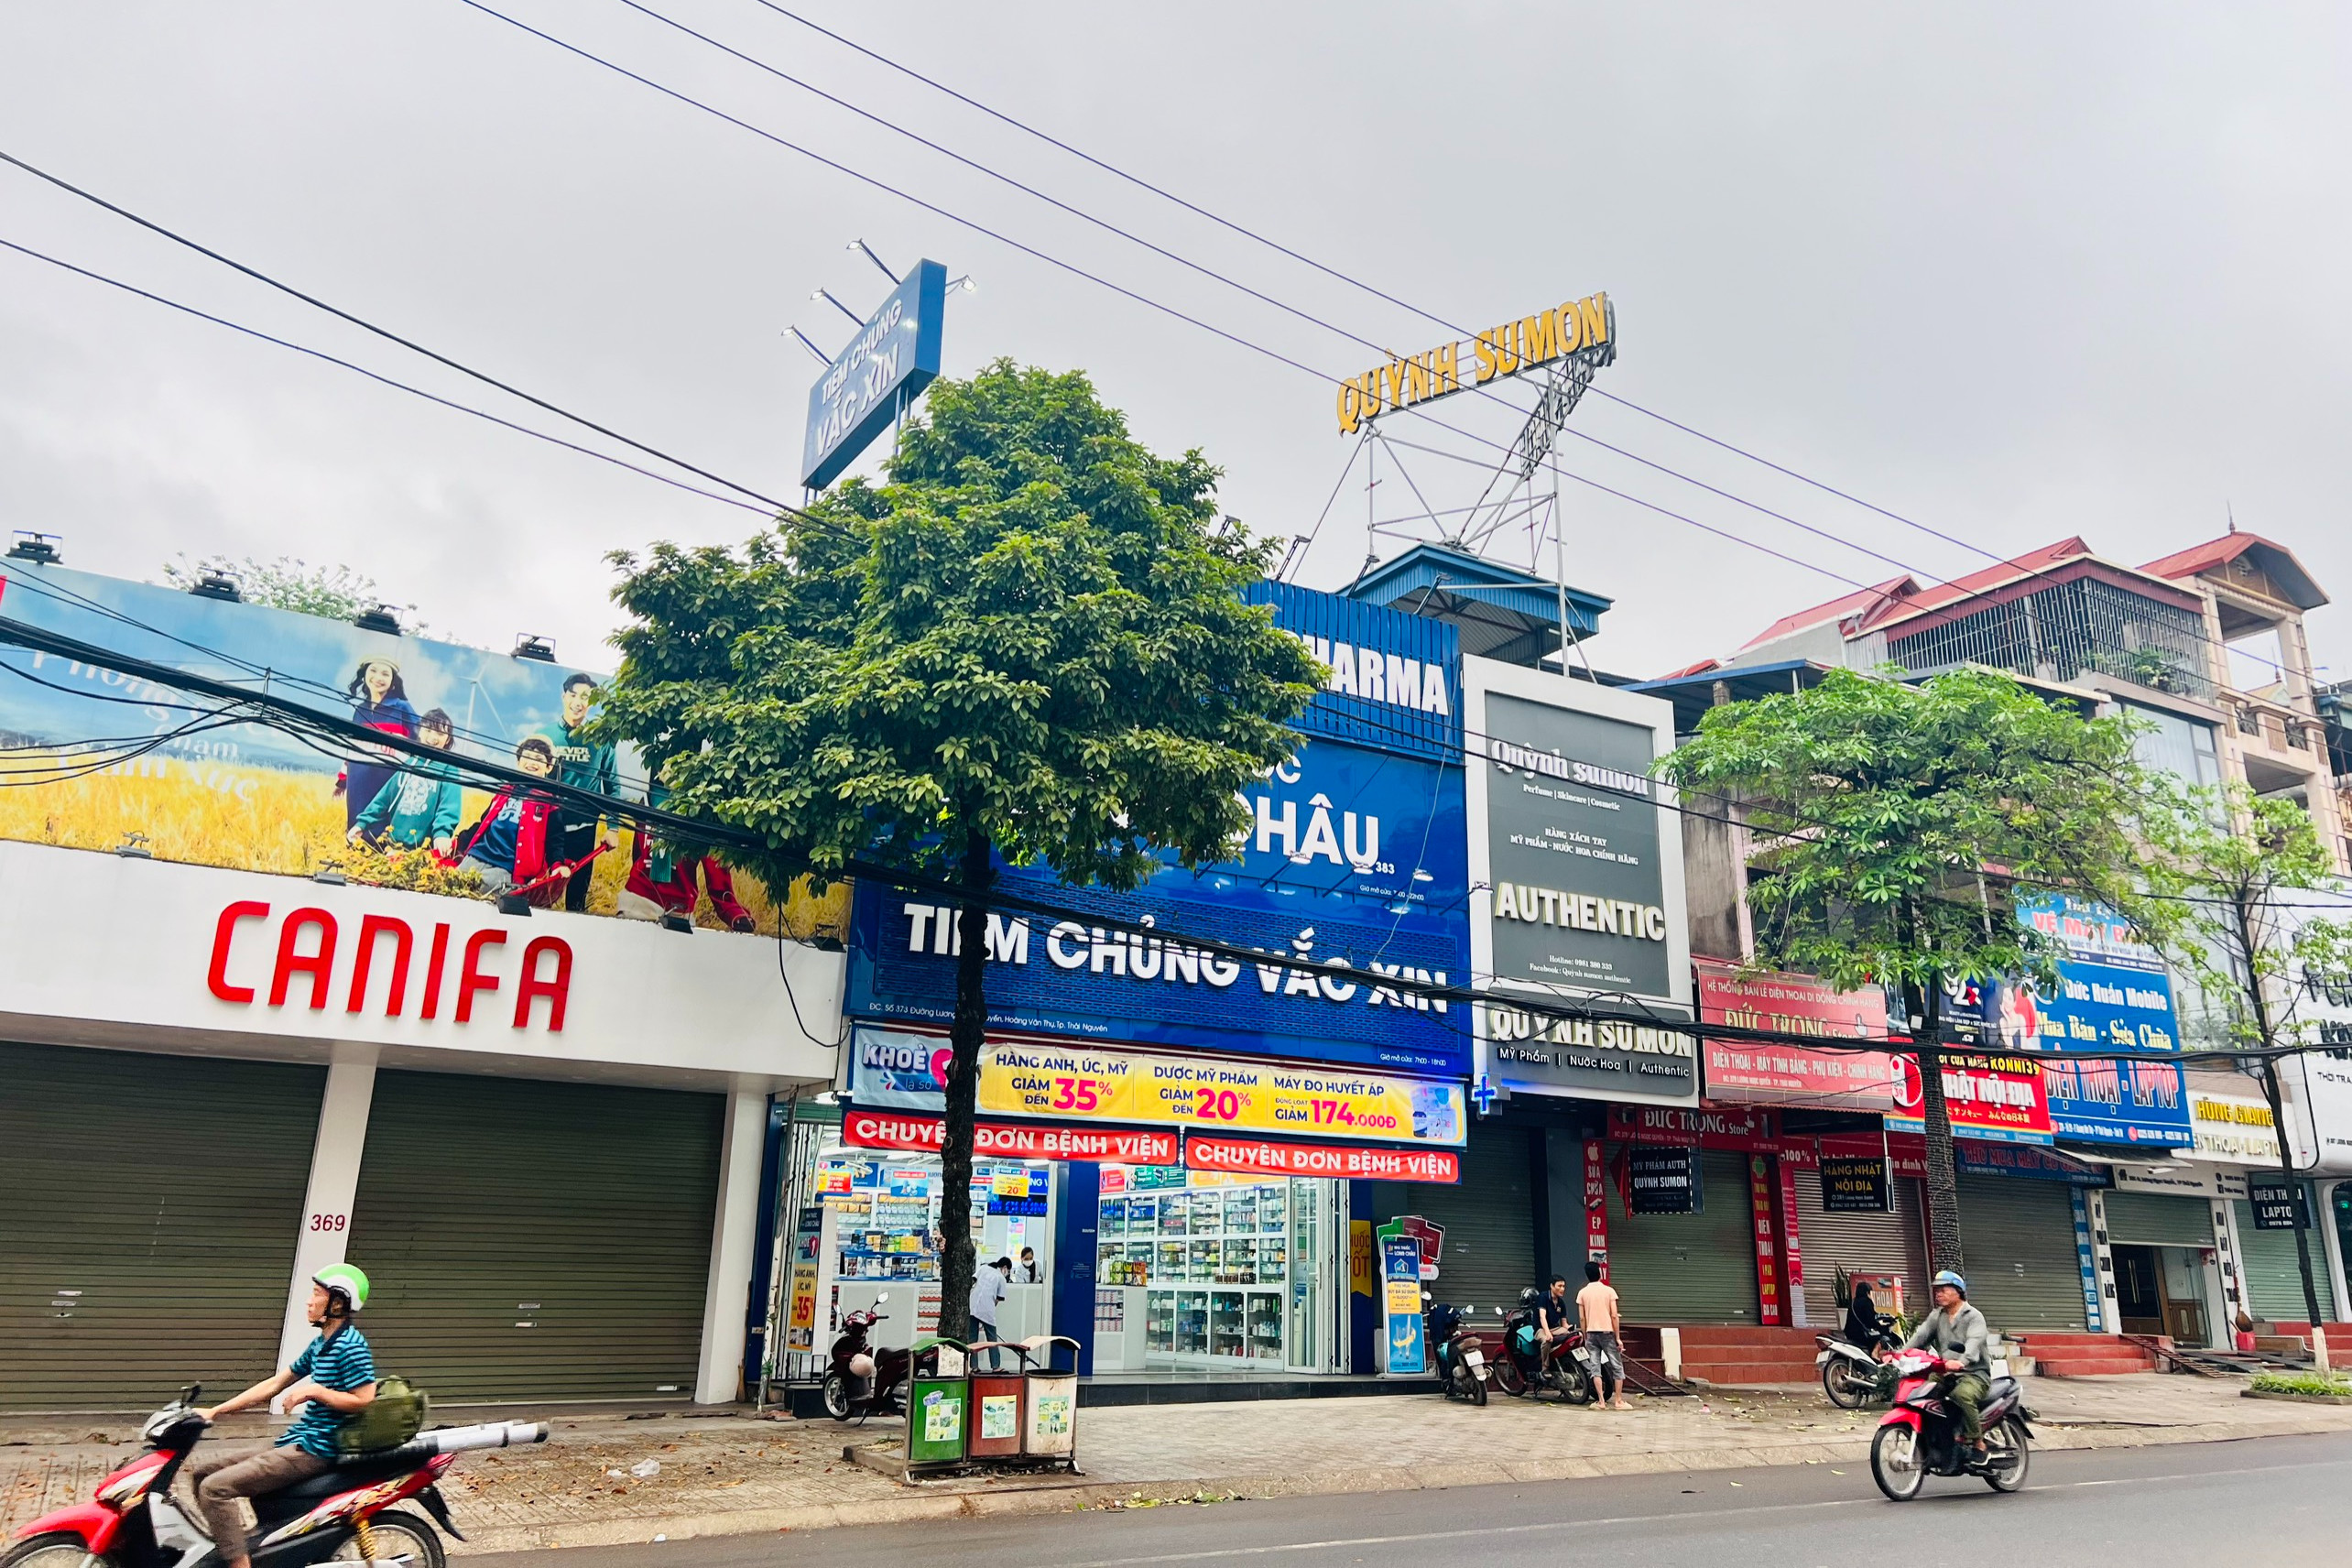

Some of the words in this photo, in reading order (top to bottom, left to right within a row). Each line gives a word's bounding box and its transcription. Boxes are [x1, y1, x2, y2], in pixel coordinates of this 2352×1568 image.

[822, 362, 849, 406] TIÊM
[851, 299, 902, 370] CHỦNG
[1336, 348, 1460, 438] QUỲNH
[1475, 291, 1610, 385] SUMON
[817, 388, 857, 457] VẮC
[861, 343, 899, 413] XIN
[1290, 632, 1449, 715] HARMA
[1491, 739, 1569, 779] Quỳnh
[1573, 759, 1649, 796] sumon
[1523, 784, 1553, 799] Perfume
[1557, 790, 1586, 805] Skincare
[1590, 798, 1620, 811] Cosmetic
[1227, 789, 1378, 868] HÂU
[1545, 827, 1567, 841] HÀNG
[1569, 832, 1590, 845] XÁCH
[1592, 837, 1607, 847] TAY
[1575, 846, 1592, 857] HOA
[1376, 861, 1395, 875] 383
[1495, 881, 1666, 942] AUTHENTIC
[207, 900, 572, 1031] CANIFA
[904, 903, 1029, 964] TIM
[1046, 914, 1240, 986] CHỦNG
[1254, 927, 1356, 1002] VẮC
[1367, 962, 1447, 1013] XIN
[1550, 954, 1573, 965] Hotline:
[2125, 987, 2167, 1011] Mobile
[1599, 1019, 1693, 1058] SUMON
[996, 1051, 1040, 1068] HÀNG
[1042, 1056, 1079, 1073] ANH,
[1082, 1055, 1104, 1075] ÚC,
[1107, 1057, 1128, 1076] MỸ
[1600, 1059, 1621, 1072] Hoa
[1640, 1062, 1690, 1077] Authentic
[1011, 1073, 1051, 1092] GIẢM
[1154, 1065, 1192, 1083] DƯỢC
[1196, 1067, 1217, 1083] MỸ
[1219, 1070, 1258, 1087] PHẨM
[1274, 1076, 1301, 1090] MÁY
[1304, 1079, 1323, 1092] ĐO
[1326, 1081, 1366, 1095] HUYẾT
[1368, 1083, 1385, 1096] ÁP
[2127, 1060, 2179, 1109] LAPTOP
[1025, 1092, 1049, 1105] ĐẾN
[1160, 1085, 1193, 1101] GIẢM
[1172, 1102, 1193, 1115] ĐẾN
[1275, 1106, 1308, 1122] GIẢM
[2235, 1104, 2274, 1127] GIANG
[855, 1115, 947, 1145] CHUYÊ
[975, 1127, 1035, 1150] ĐƠN
[1043, 1129, 1107, 1158] BỆNH
[1111, 1133, 1168, 1161] VIỆN
[1728, 1123, 1749, 1136] Store
[1194, 1144, 1286, 1169] CHUYÊN
[1292, 1148, 1342, 1170] ĐƠN
[1348, 1150, 1400, 1177] BỆNH
[1408, 1152, 1452, 1179] VIỆN
[1667, 1160, 1686, 1171] AUTH
[1785, 1149, 1811, 1162] 100%
[1824, 1162, 1852, 1176] HÀNG
[1854, 1161, 1881, 1179] NHẬT
[1660, 1176, 1687, 1188] SUMON
[1835, 1178, 1854, 1194] NỘI
[1855, 1181, 1873, 1194] ĐỊA
[2261, 1205, 2292, 1218] LAPTO
[310, 1214, 345, 1232] 369
[1351, 1248, 1370, 1278] ỐT
